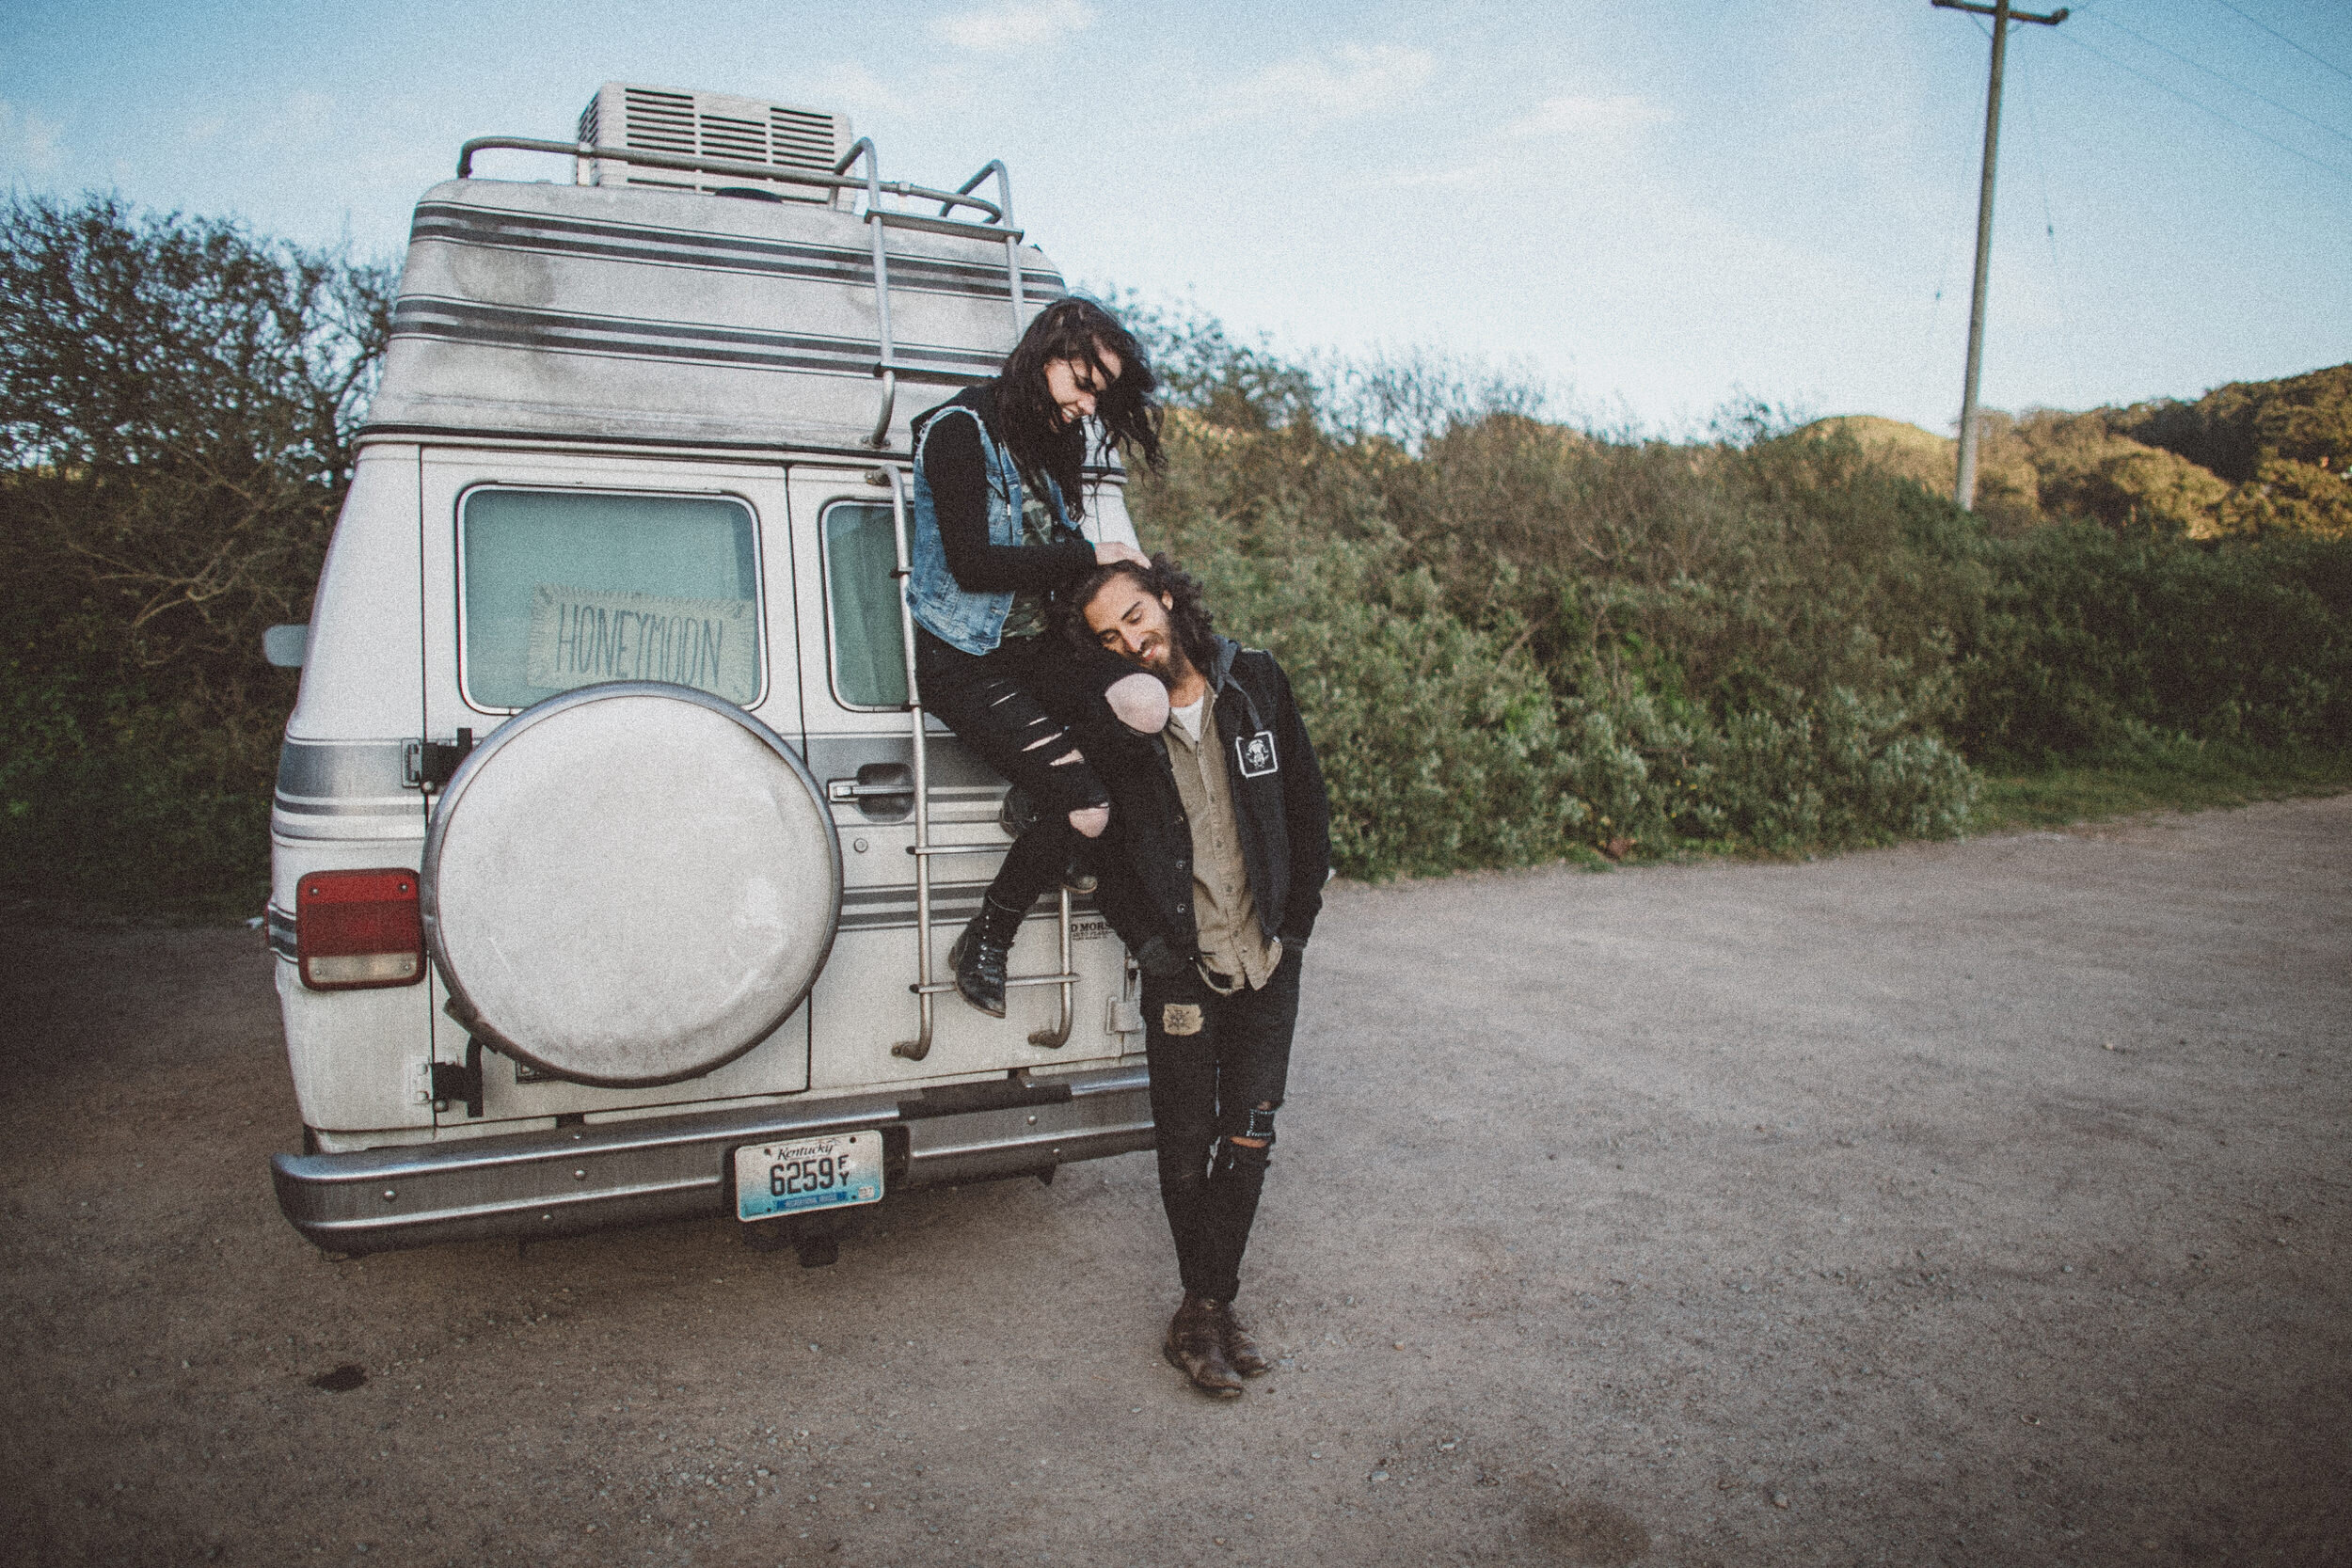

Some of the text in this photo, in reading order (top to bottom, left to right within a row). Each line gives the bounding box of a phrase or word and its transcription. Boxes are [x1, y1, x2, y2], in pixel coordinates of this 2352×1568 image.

[557, 603, 723, 688] HONEYMOON
[777, 1143, 833, 1161] Kentucky
[770, 1156, 834, 1196] 6259
